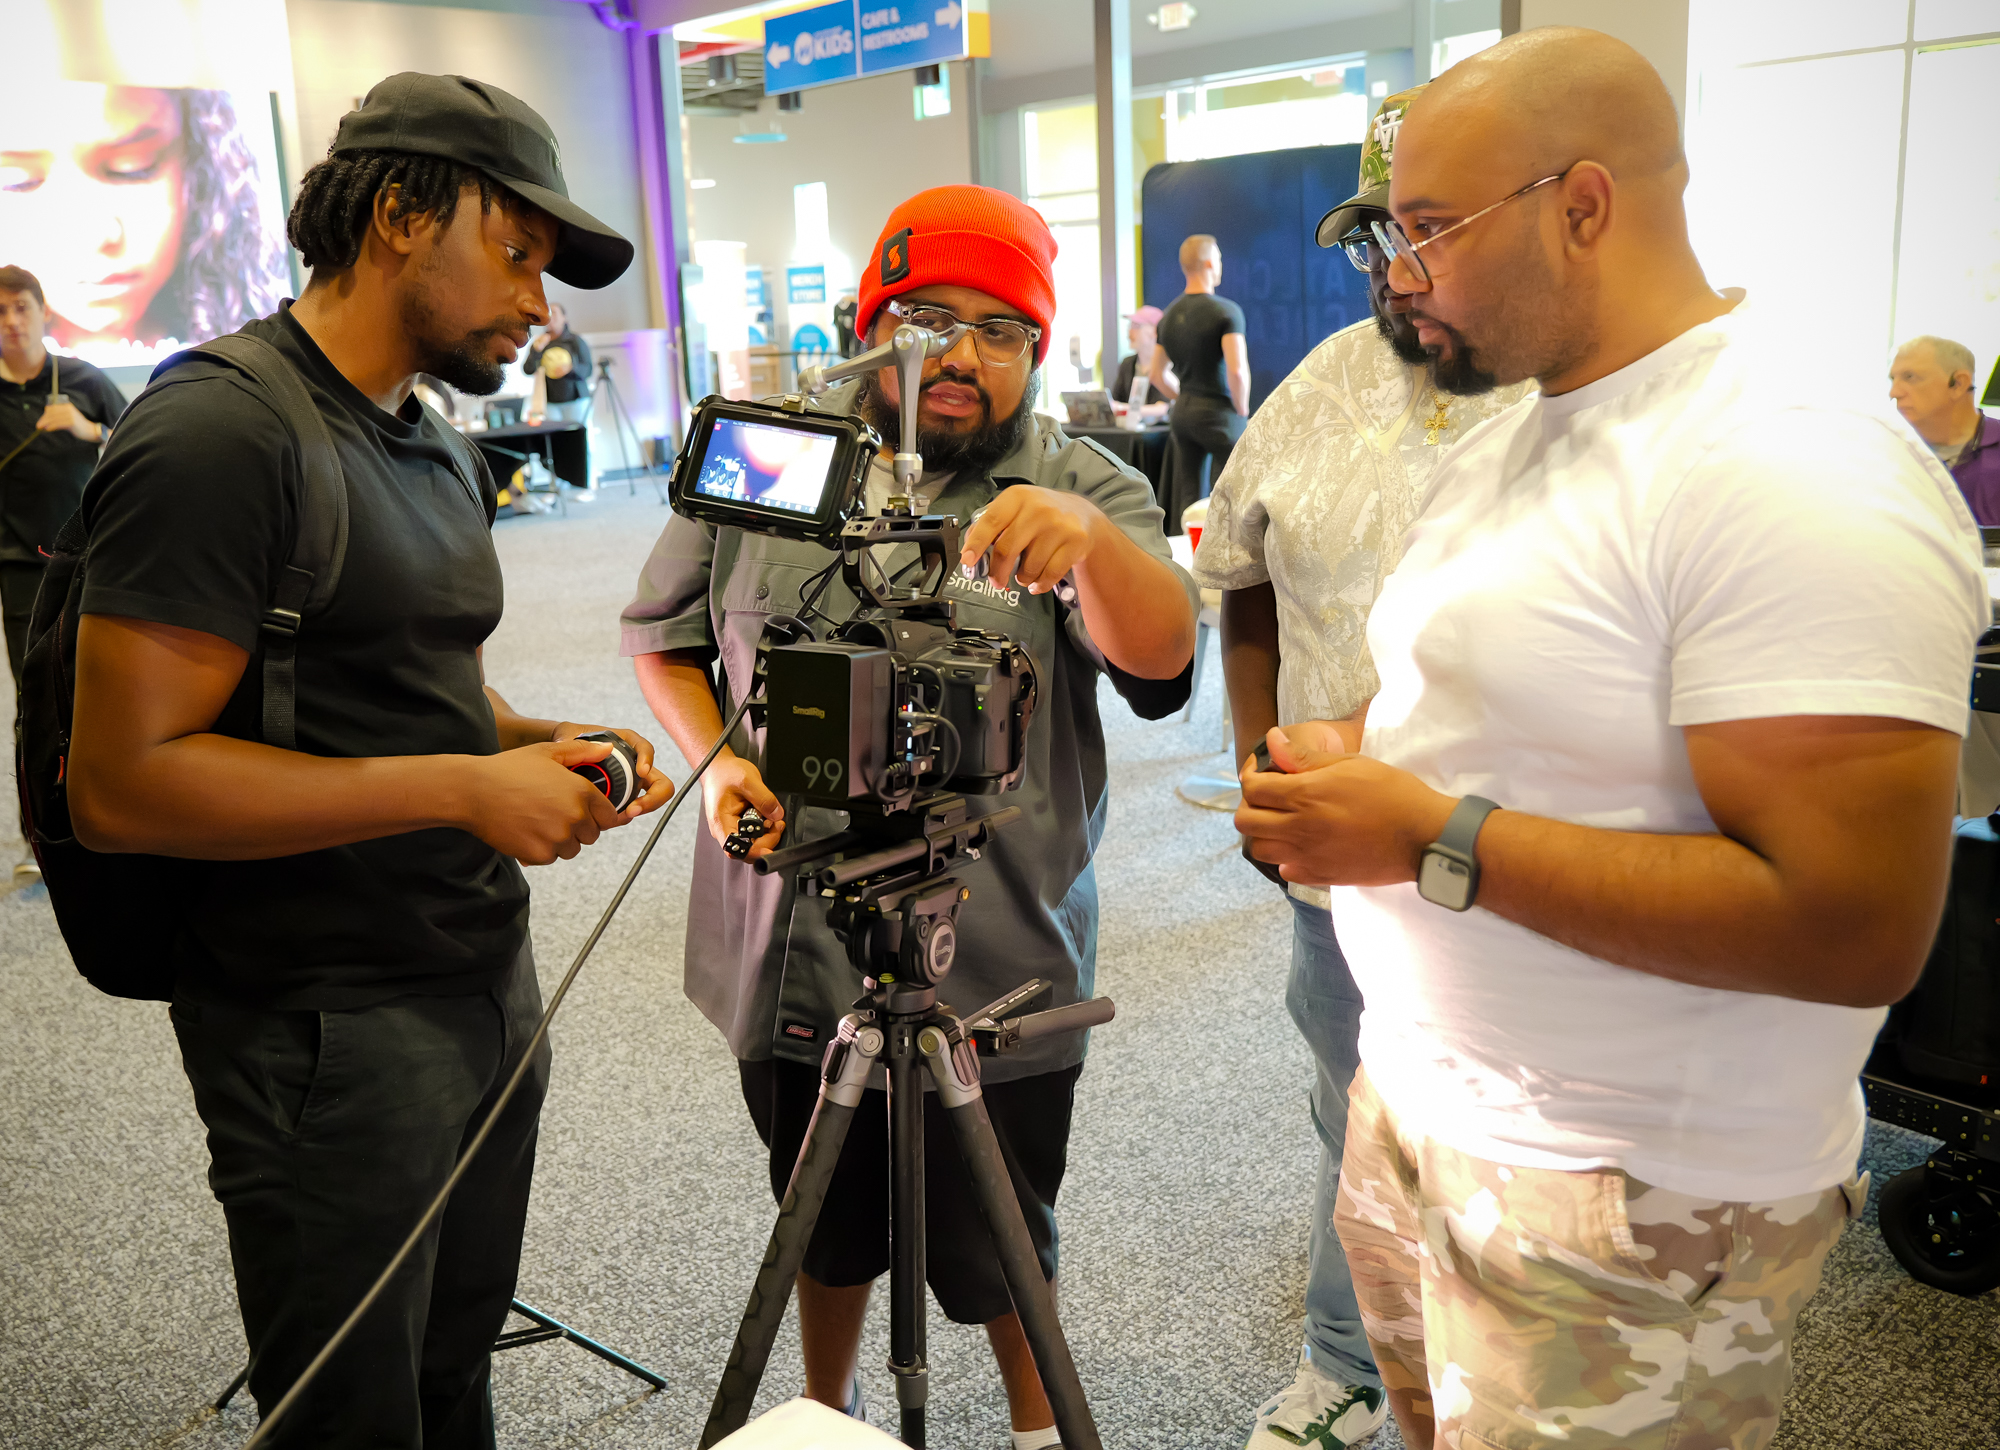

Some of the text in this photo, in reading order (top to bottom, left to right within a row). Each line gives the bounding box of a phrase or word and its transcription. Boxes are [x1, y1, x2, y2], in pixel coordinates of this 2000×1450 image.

[814, 29, 854, 60] KIDS
[862, 22, 929, 51] RESTROOMS
[793, 705, 825, 719] SmallRig
[802, 756, 843, 792] 99
